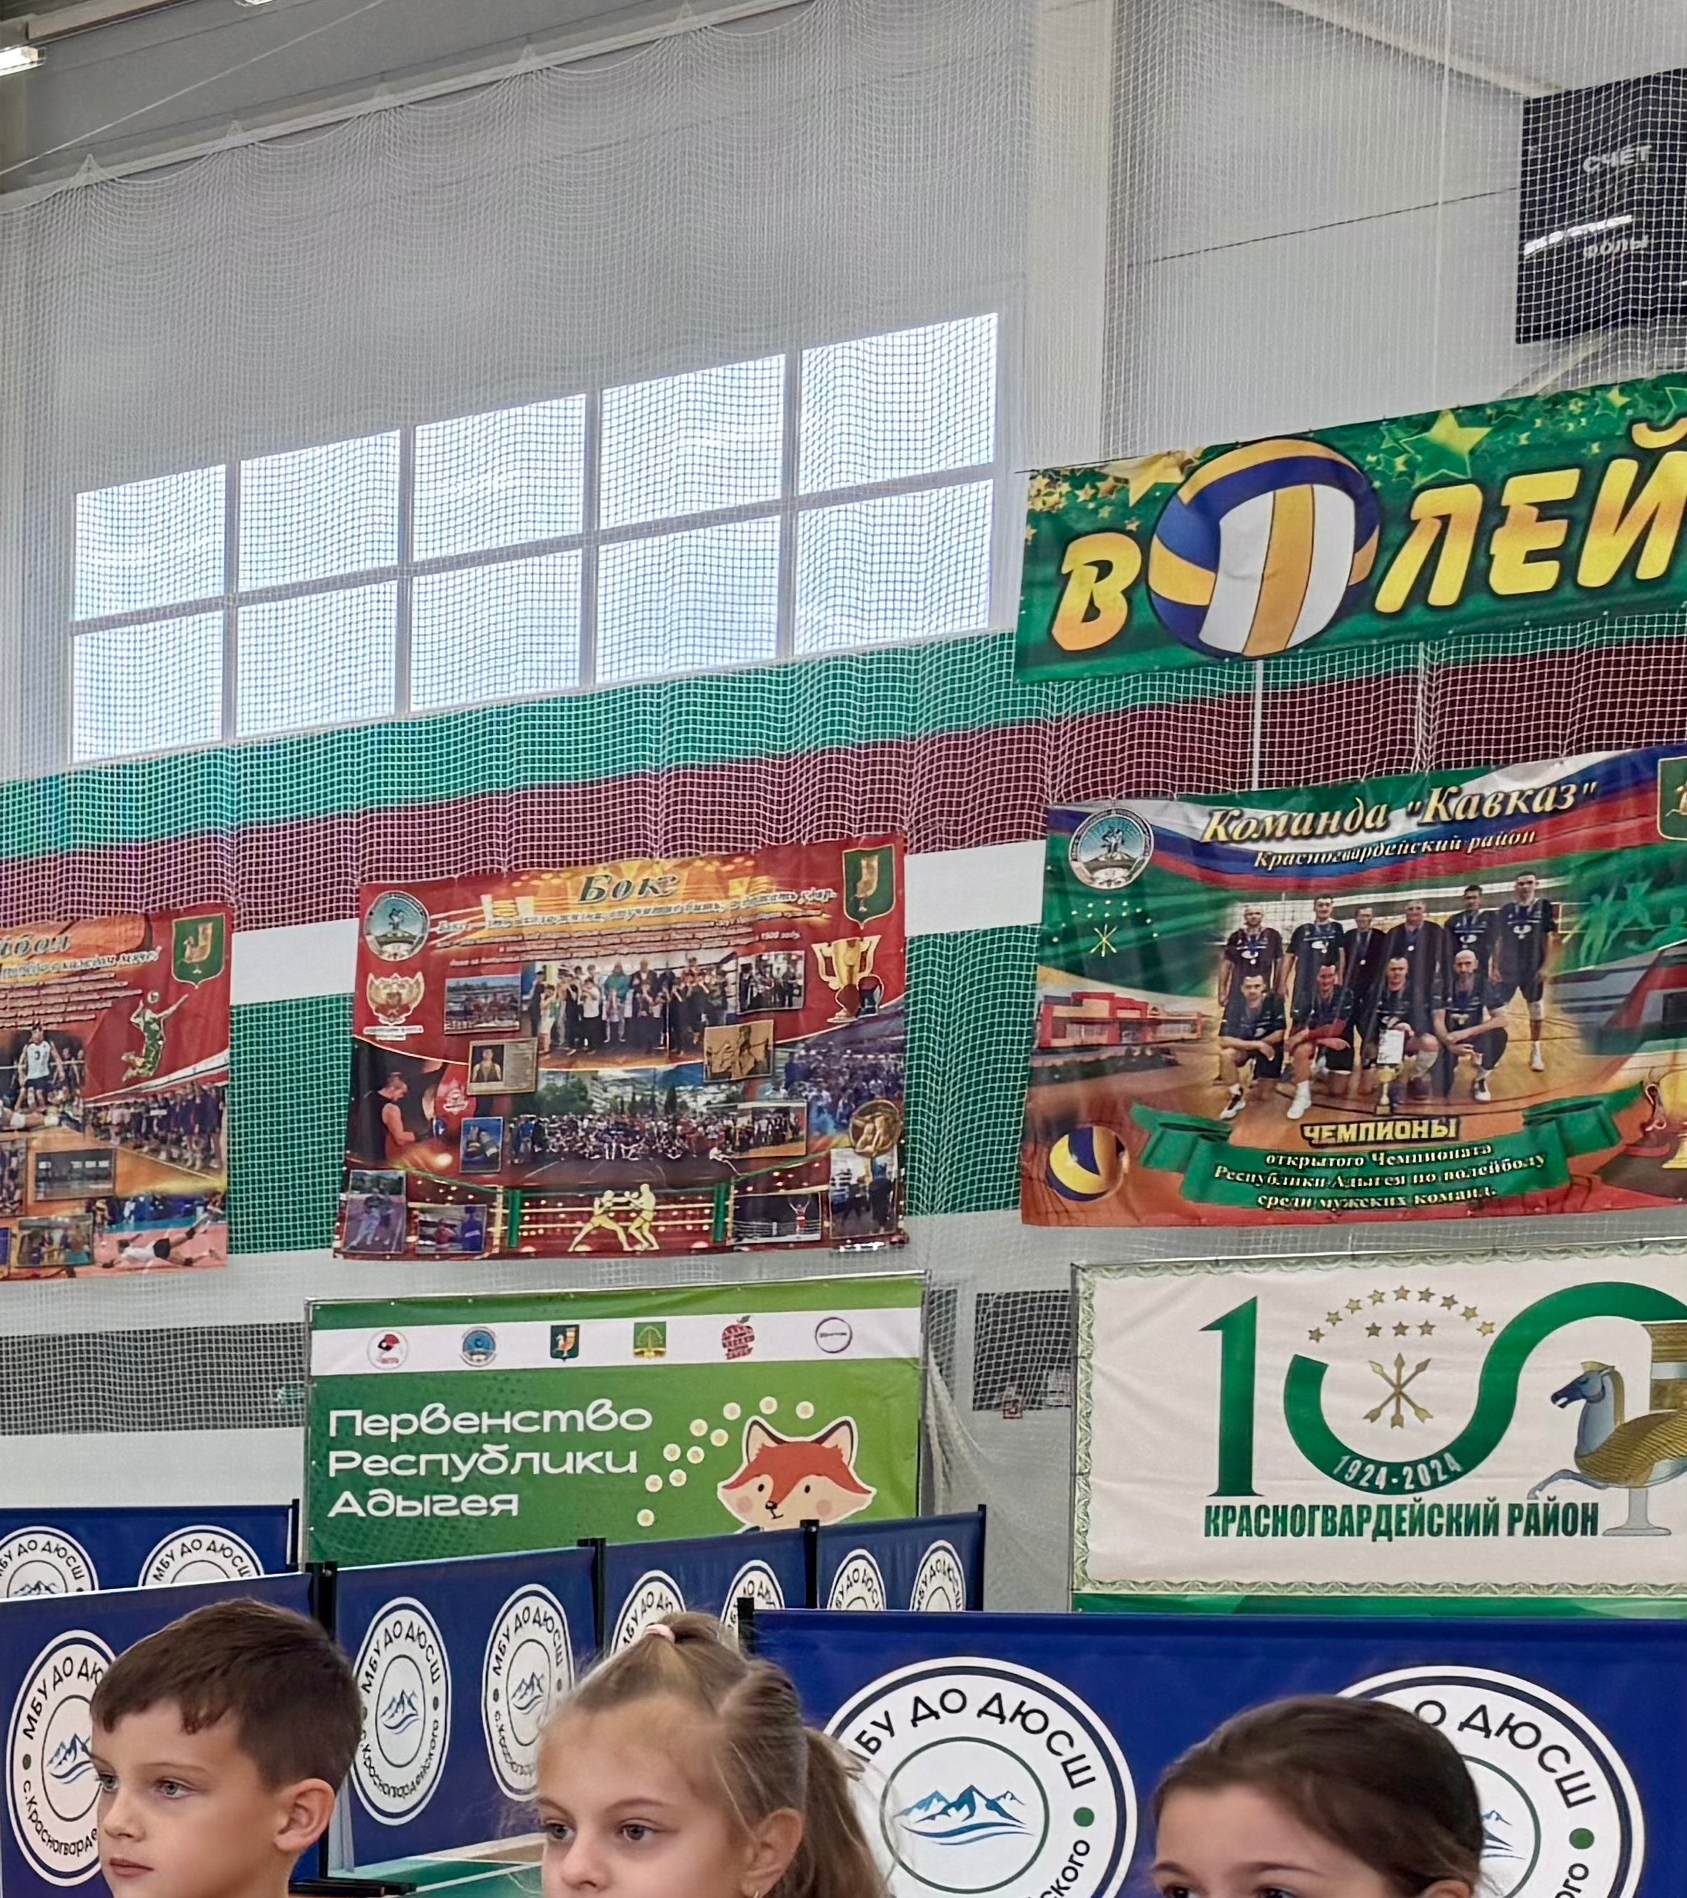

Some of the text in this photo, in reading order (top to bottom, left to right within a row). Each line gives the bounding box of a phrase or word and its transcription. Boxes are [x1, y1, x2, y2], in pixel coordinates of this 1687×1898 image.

[1202, 782, 1599, 844] Команда "Кавказ"
[1302, 1118, 1458, 1145] ЧЕМПИОНЫ
[329, 1399, 653, 1443] Первенство
[328, 1445, 639, 1483] Республики
[328, 1490, 519, 1518] Адыгея
[1204, 1497, 1599, 1543] КРАСНОГВАРДЕЙСКИЙ РАЙОН
[17, 1539, 38, 1557] ДО
[41, 1539, 85, 1581] ДЮСШ
[152, 1551, 176, 1582] МБУ
[180, 1538, 203, 1558] ДО
[23, 1656, 105, 1740] МБУ ДО ДЮ
[909, 1688, 968, 1728] ДО
[977, 1692, 1097, 1791] ДЮСШ
[1457, 1704, 1597, 1809] ДЮСШ
